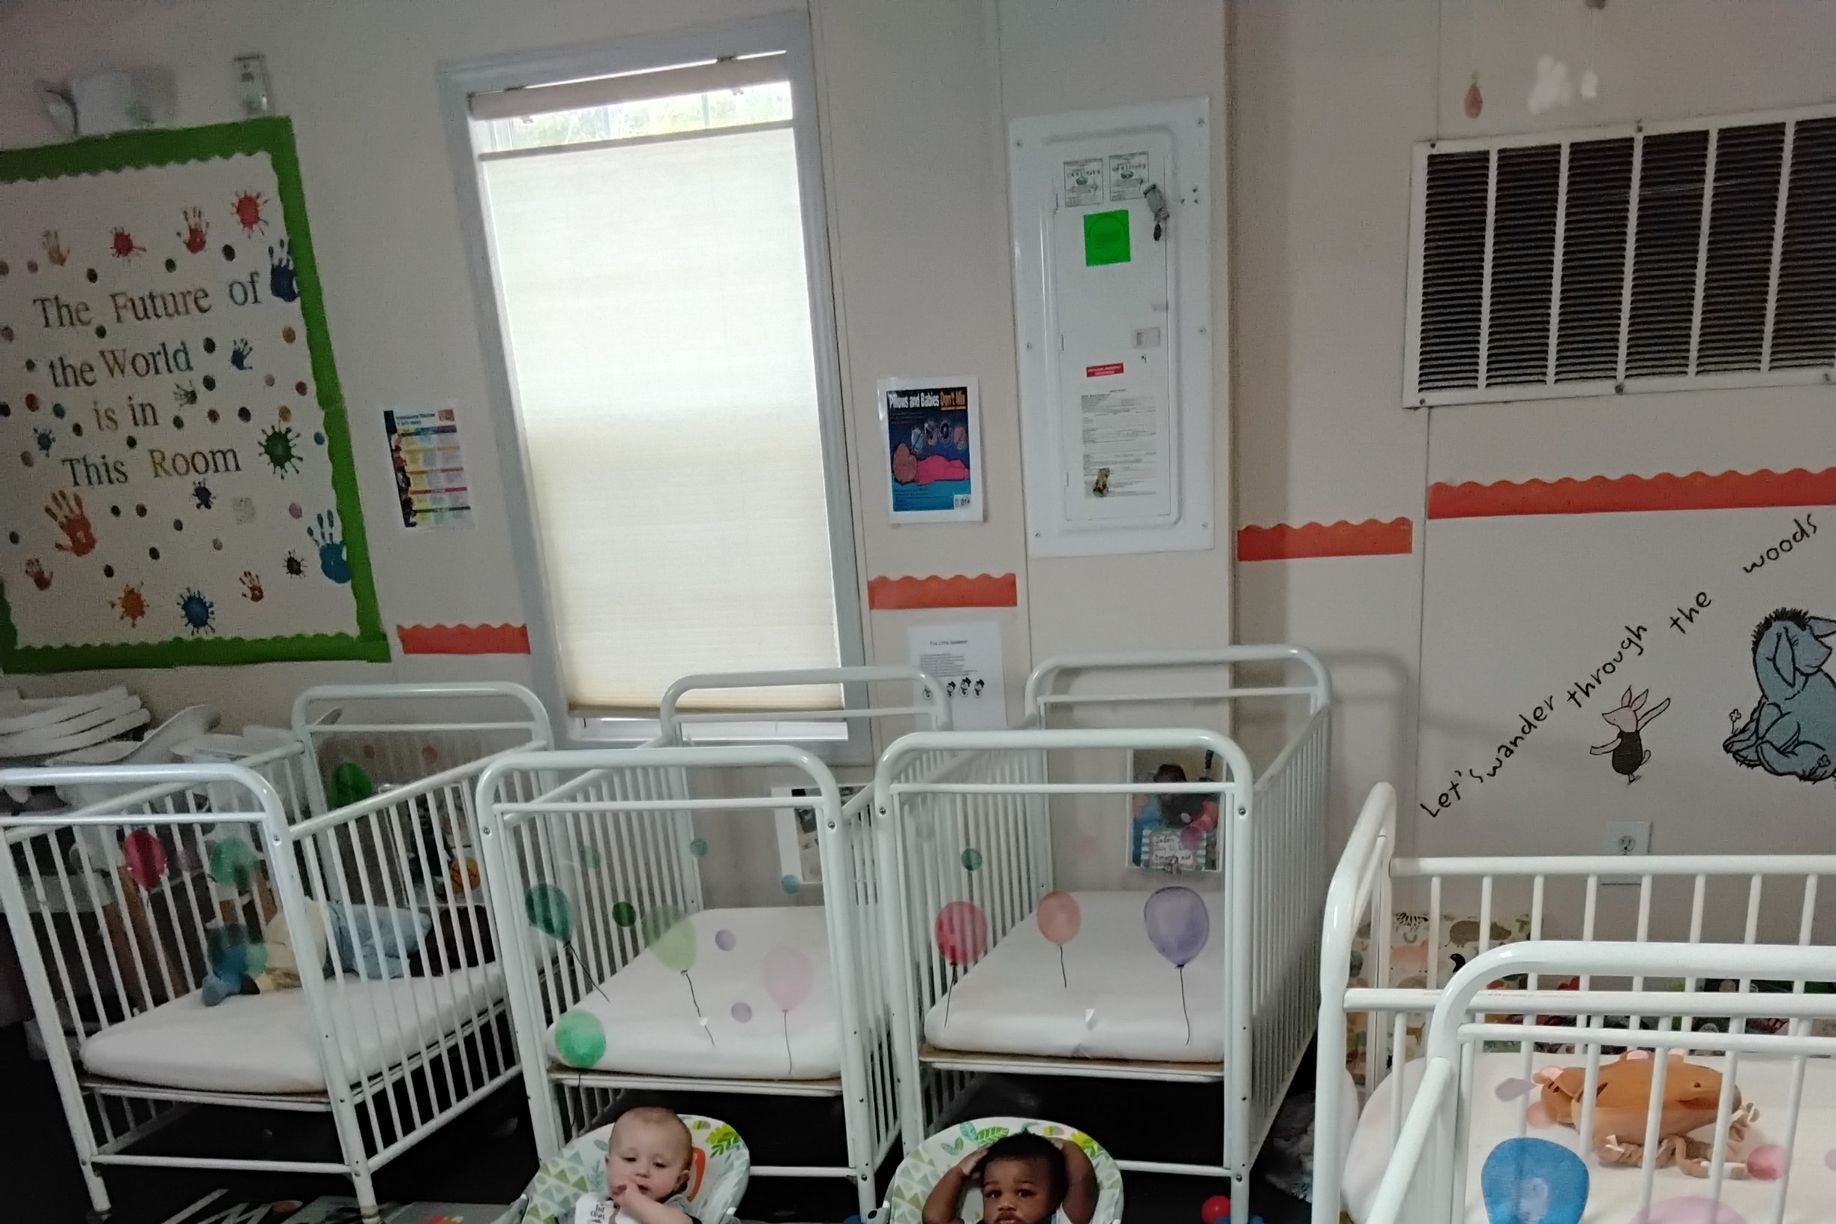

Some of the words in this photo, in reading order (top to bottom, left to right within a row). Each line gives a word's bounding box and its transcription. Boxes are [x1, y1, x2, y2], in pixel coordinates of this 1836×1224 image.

[33, 295, 93, 328] The
[109, 287, 212, 324] Future
[229, 271, 262, 306] of
[49, 355, 97, 388] the
[100, 340, 194, 379] World
[92, 401, 119, 432] is
[127, 395, 159, 427] in
[888, 392, 908, 408] Pillows
[909, 393, 920, 408] and
[921, 391, 939, 407] Babies
[940, 390, 955, 407] Don't
[61, 455, 129, 487] This
[147, 447, 242, 478] Room
[1420, 770, 1484, 819] Let's
[1486, 694, 1556, 779] wander
[1566, 622, 1648, 710] through
[1669, 591, 1712, 634] the
[1742, 513, 1818, 573] woods
